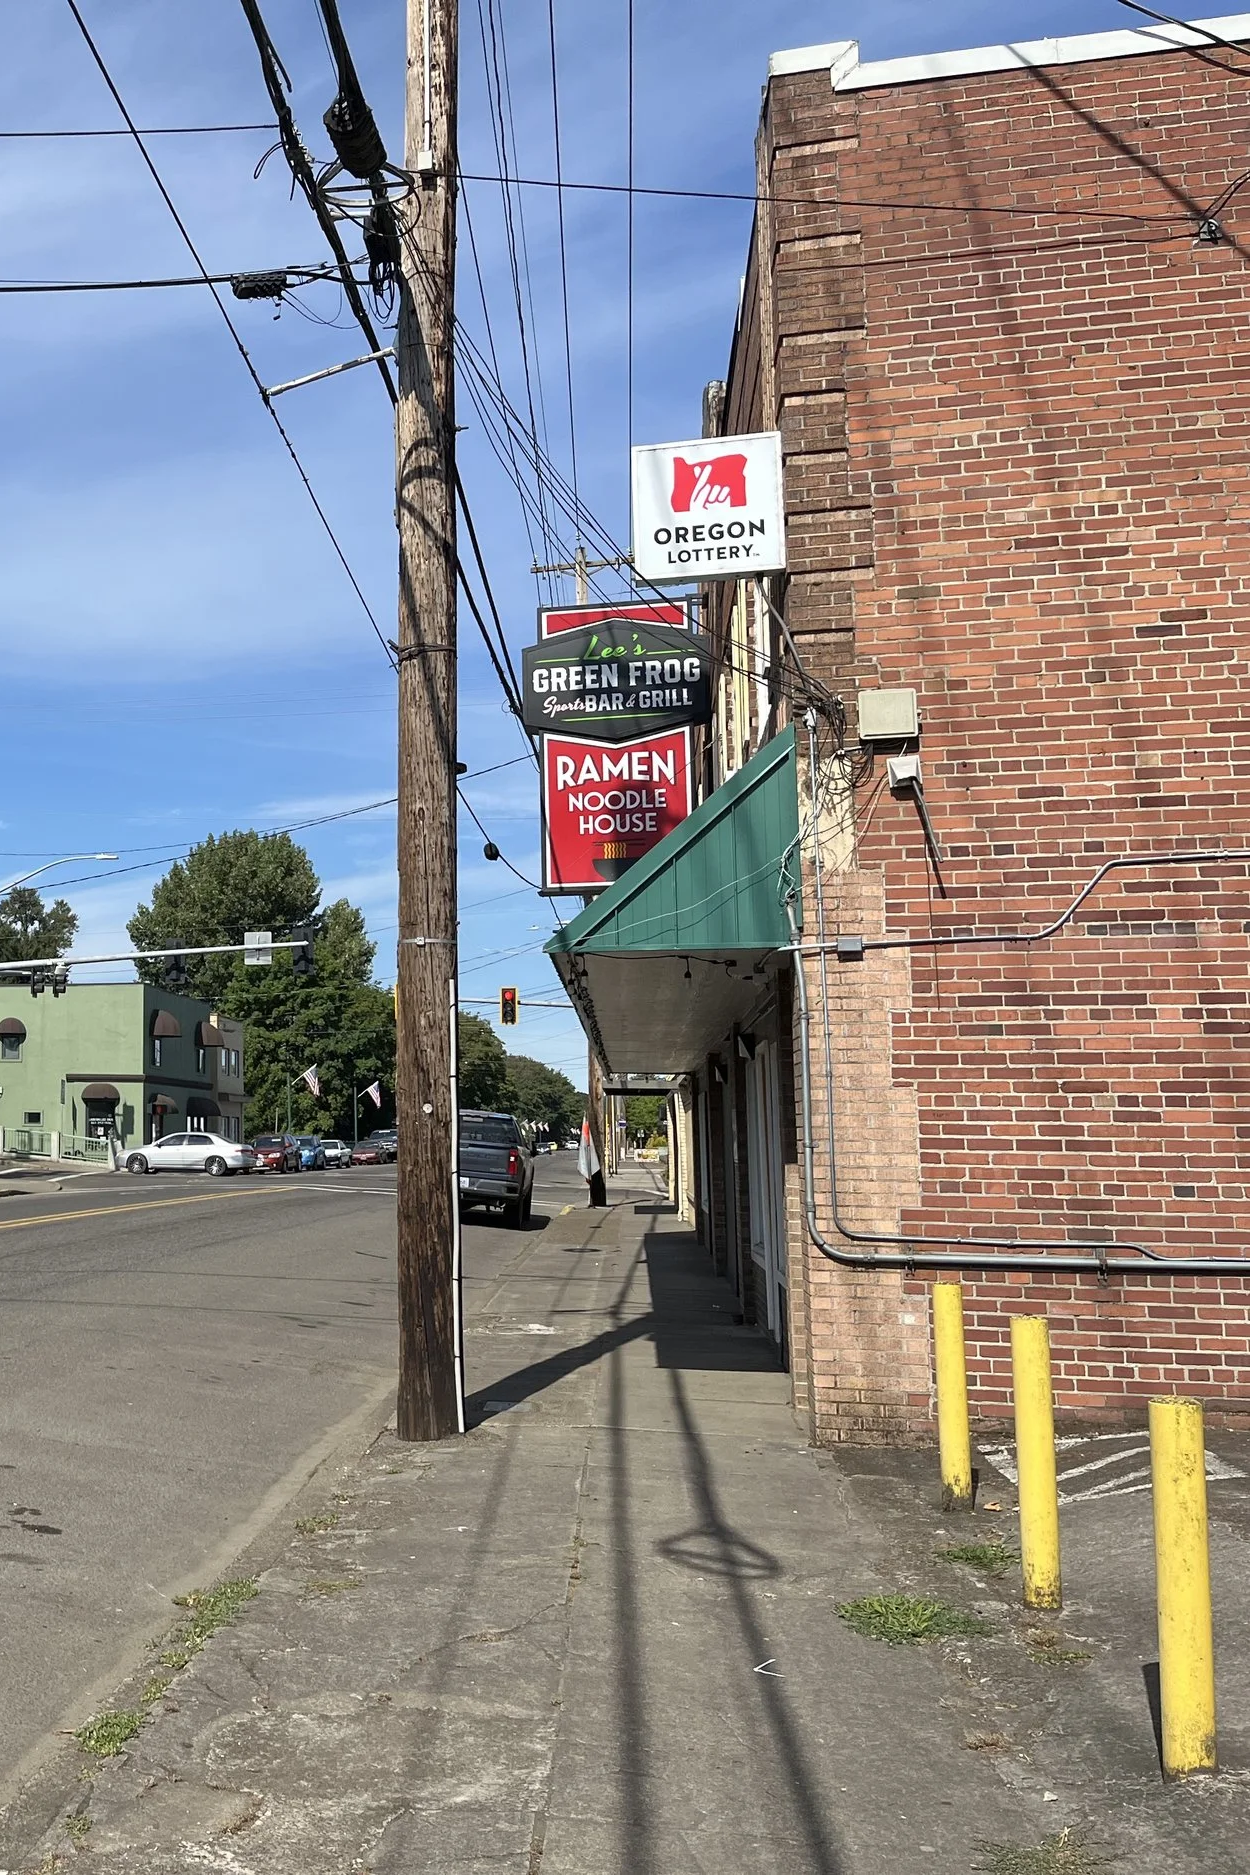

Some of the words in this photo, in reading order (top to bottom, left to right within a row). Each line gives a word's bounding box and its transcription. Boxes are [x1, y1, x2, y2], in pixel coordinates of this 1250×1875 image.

[653, 518, 766, 545] OREGON
[667, 543, 754, 564] LOTTERY
[583, 633, 647, 660] Lee's
[532, 662, 619, 693] GREEN
[628, 657, 701, 686] FROG
[542, 695, 586, 718] Sports
[584, 692, 624, 713] BAR
[625, 693, 637, 708] &
[638, 687, 693, 709] GRILL
[556, 749, 675, 791] RAMEN
[568, 788, 667, 812] NOODLE
[579, 812, 658, 834] HOUSE
